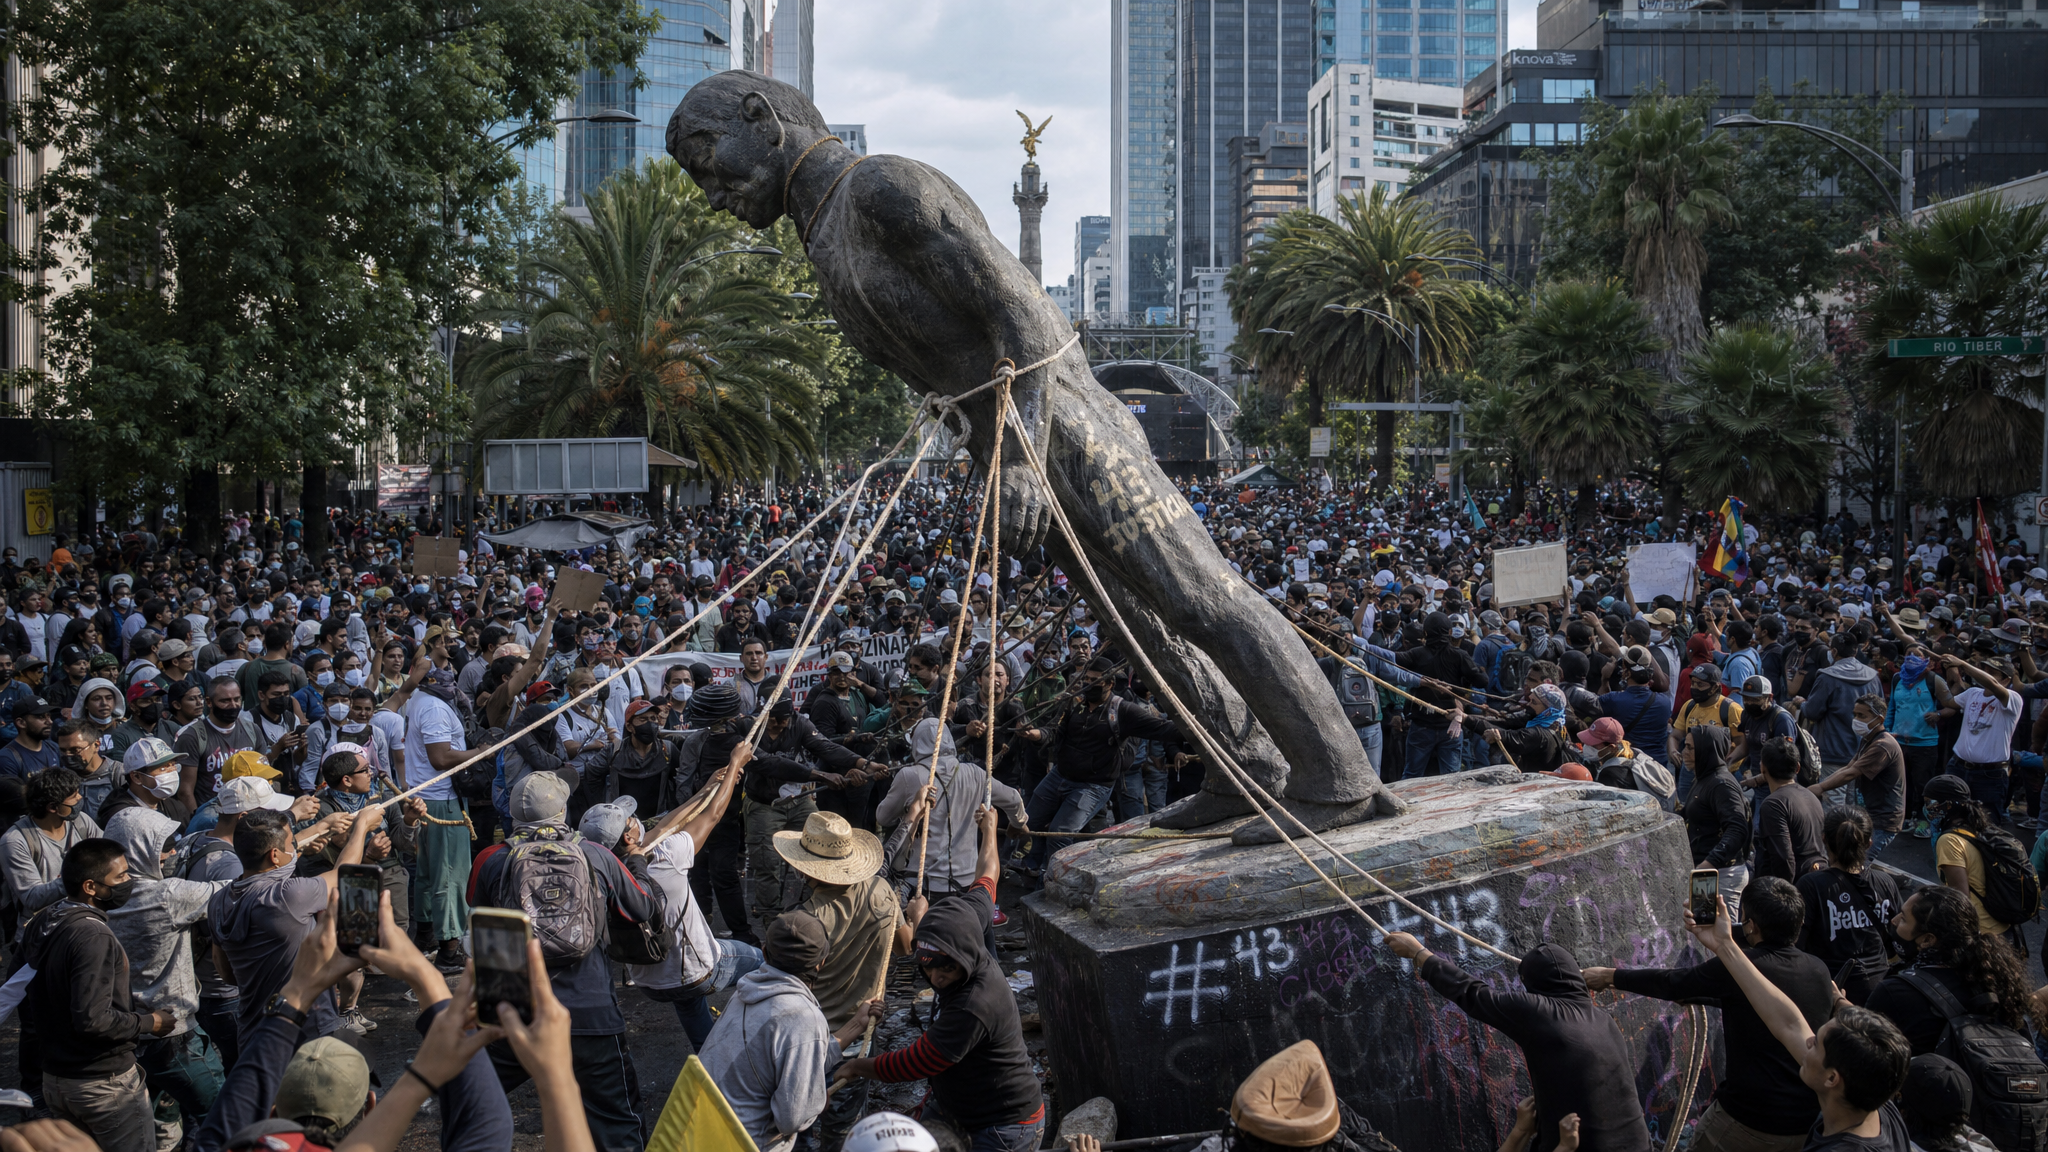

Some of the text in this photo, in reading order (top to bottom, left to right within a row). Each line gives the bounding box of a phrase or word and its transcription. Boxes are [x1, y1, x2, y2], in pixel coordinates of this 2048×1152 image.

[1513, 52, 1553, 64] knova
[1963, 341, 2002, 351] TIBER
[1091, 465, 1151, 511] 43
